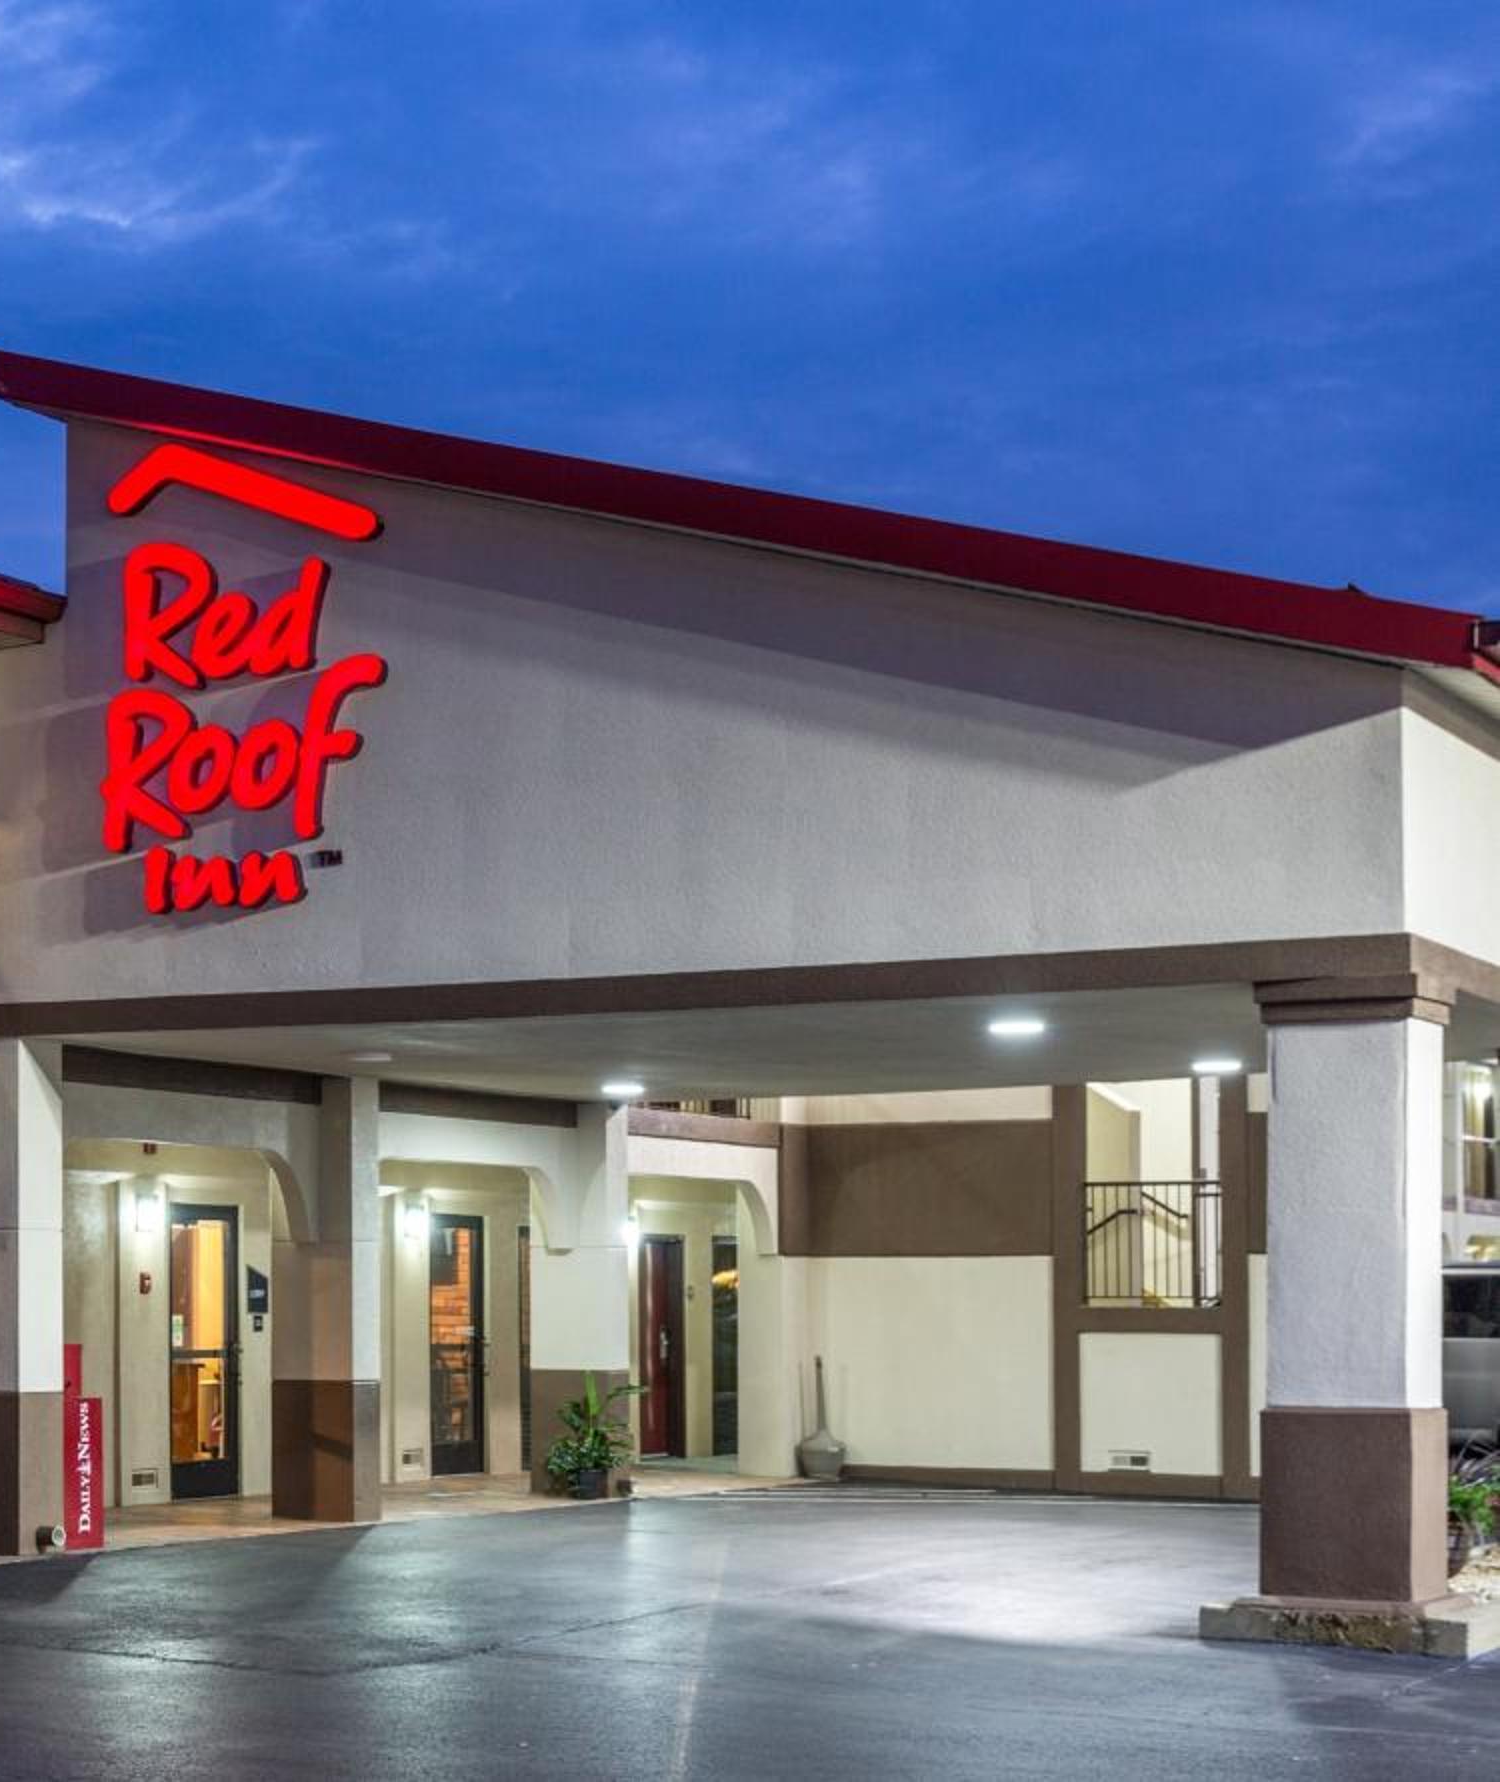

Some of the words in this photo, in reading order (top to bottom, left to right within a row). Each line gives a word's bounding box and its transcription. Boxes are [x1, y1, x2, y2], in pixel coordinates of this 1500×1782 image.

[123, 541, 329, 689] Red
[100, 652, 387, 853] Roof
[143, 844, 306, 914] Inn
